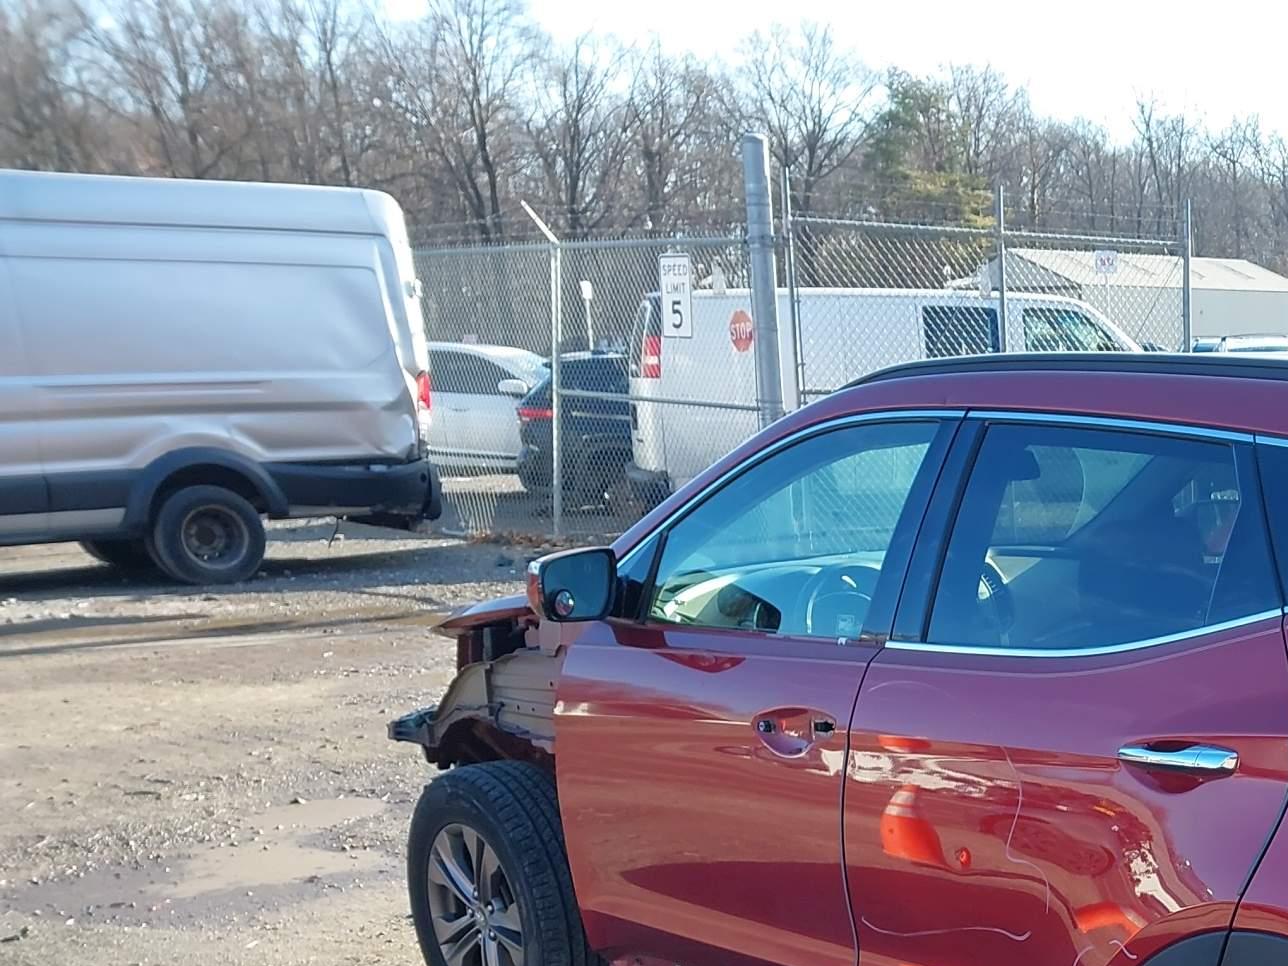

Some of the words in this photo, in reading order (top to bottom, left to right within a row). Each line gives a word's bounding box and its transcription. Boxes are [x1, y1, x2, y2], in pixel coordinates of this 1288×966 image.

[662, 263, 688, 277] SPEED
[665, 282, 686, 294] LIMIT
[671, 299, 684, 329] 5
[731, 321, 753, 341] STOP
